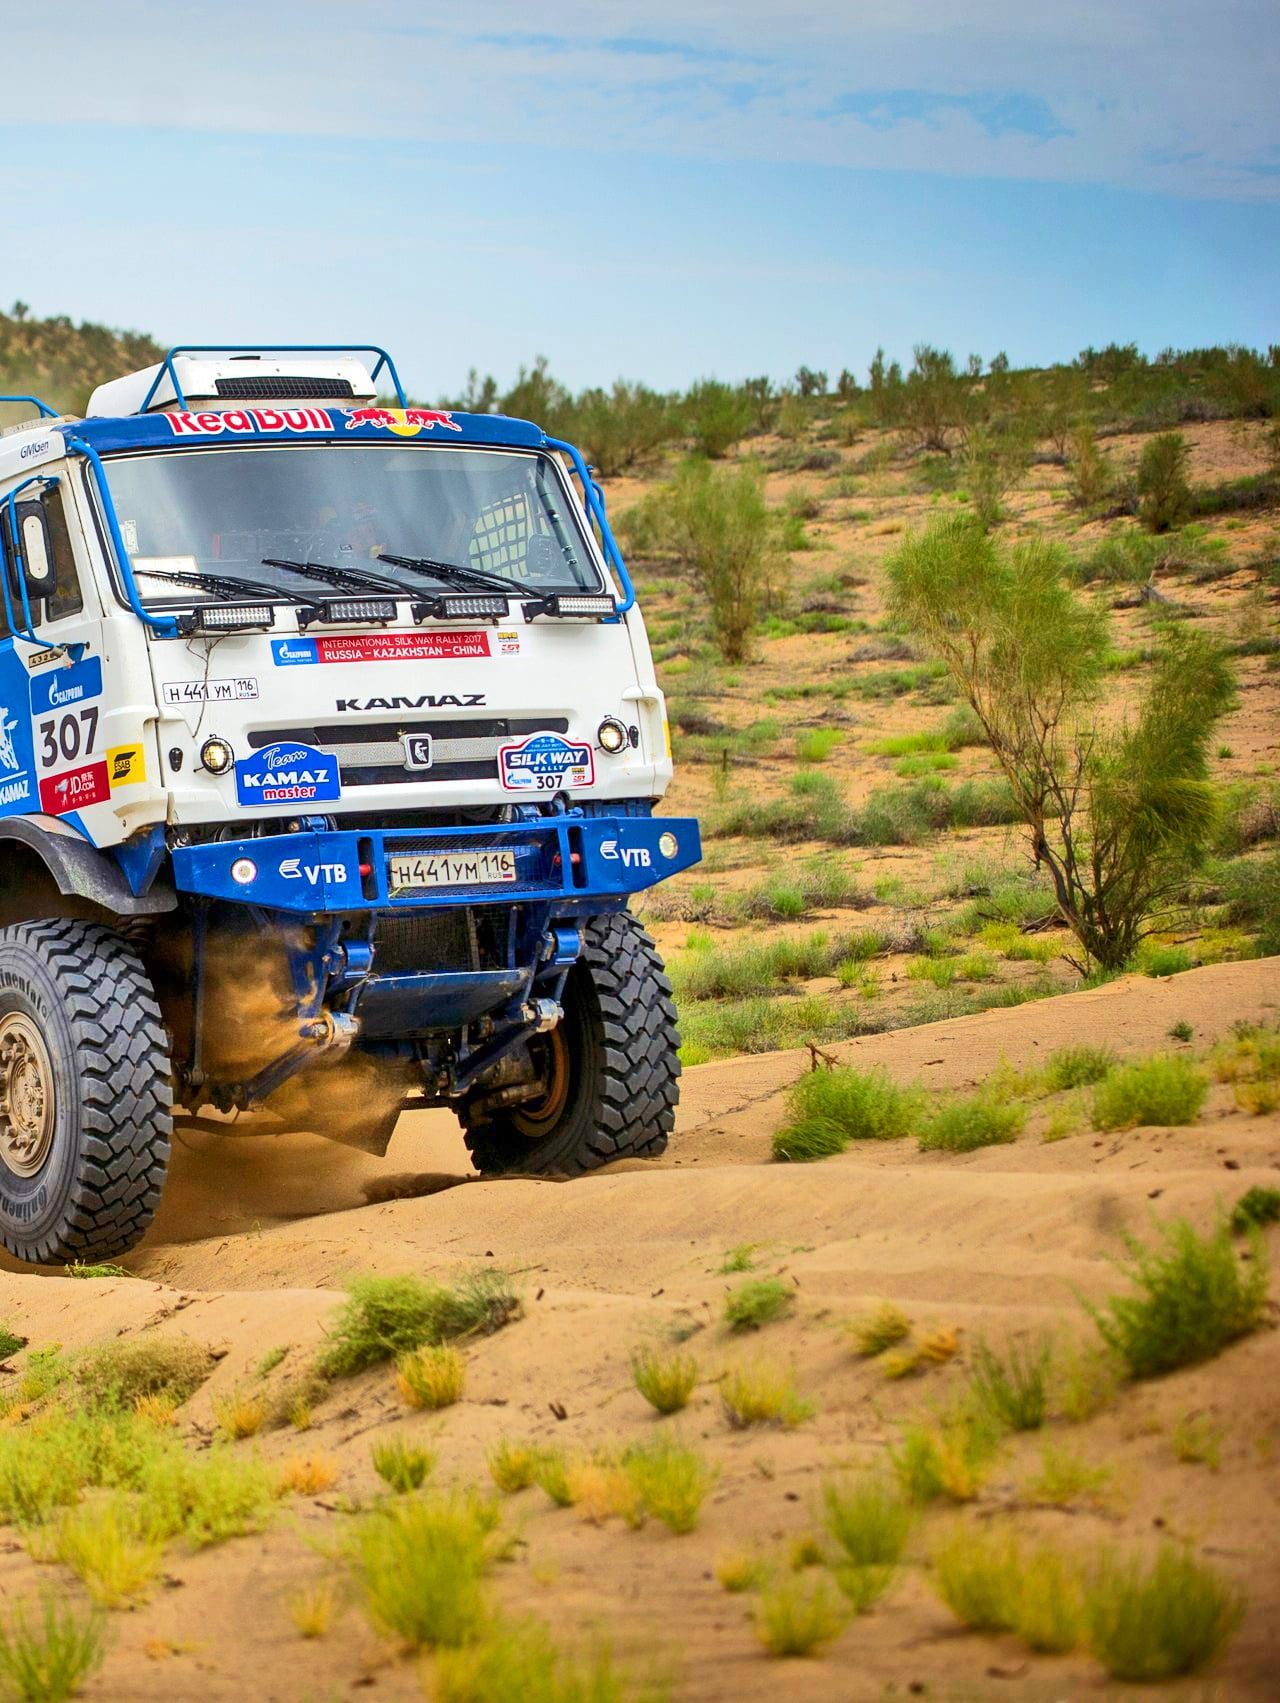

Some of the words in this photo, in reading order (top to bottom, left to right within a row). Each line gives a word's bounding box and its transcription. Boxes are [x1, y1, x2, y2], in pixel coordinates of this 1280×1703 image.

[252, 409, 333, 432] Bull
[322, 638, 393, 648] INTERNATIONAL
[394, 637, 415, 646] SILK
[415, 636, 434, 645] WAY
[436, 635, 462, 644] RALLY
[464, 634, 482, 643] 2017
[324, 648, 363, 660] RUSSIA
[373, 646, 443, 659] KAZAKHSTAN
[452, 645, 485, 655] CHINA
[237, 680, 254, 690] 116
[336, 694, 486, 712] KAMAZ
[40, 706, 99, 768] 307
[114, 760, 131, 772] ESAB
[263, 747, 308, 770] Team
[510, 752, 548, 767] SILK
[550, 750, 585, 764] WAY
[69, 776, 81, 795] JD
[243, 769, 330, 788] KAMAZ
[536, 775, 563, 789] 307
[263, 787, 316, 800] master
[480, 854, 509, 871] 116
[620, 848, 652, 867] VTB
[304, 863, 348, 885] VTB
